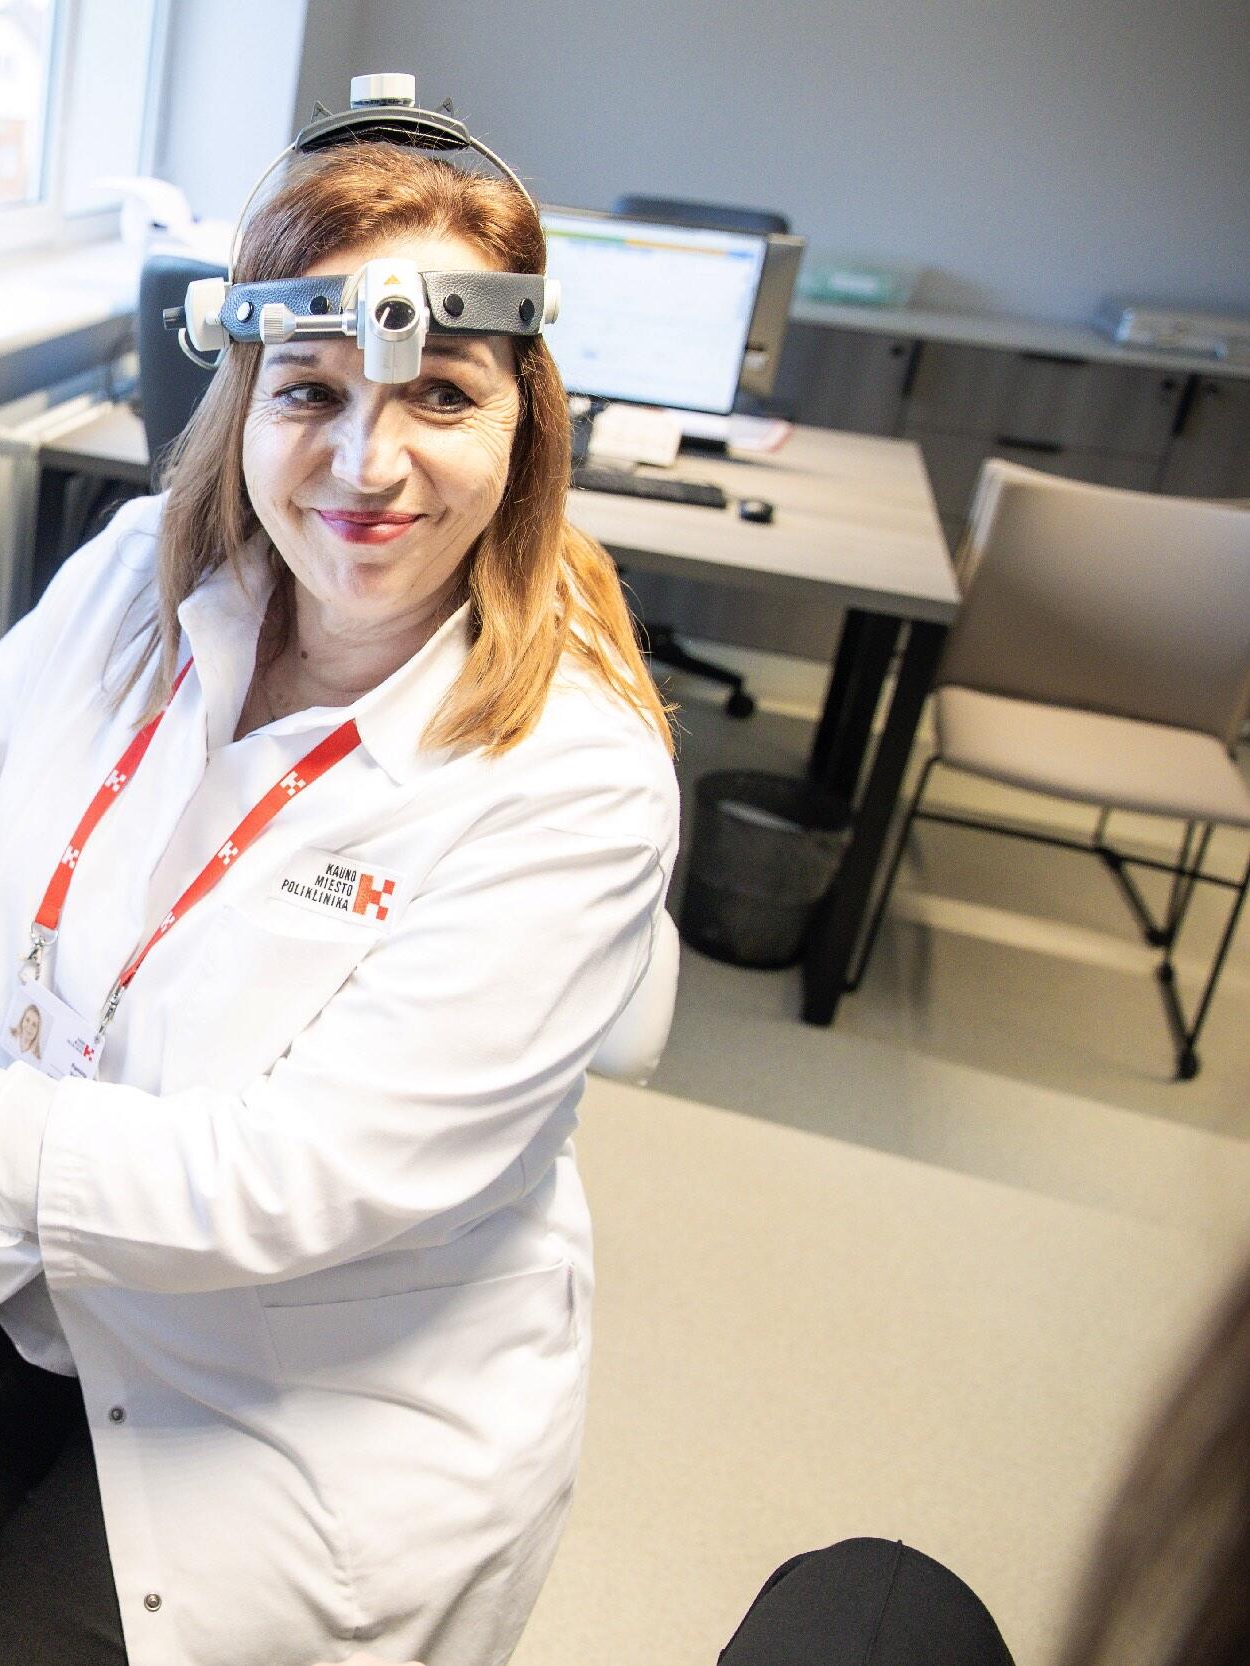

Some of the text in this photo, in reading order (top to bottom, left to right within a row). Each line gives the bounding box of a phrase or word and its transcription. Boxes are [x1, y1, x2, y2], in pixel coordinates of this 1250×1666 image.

[325, 863, 357, 883] KAUNO
[281, 878, 349, 912] POLIKLINIKA
[314, 875, 354, 897] MIESTO
